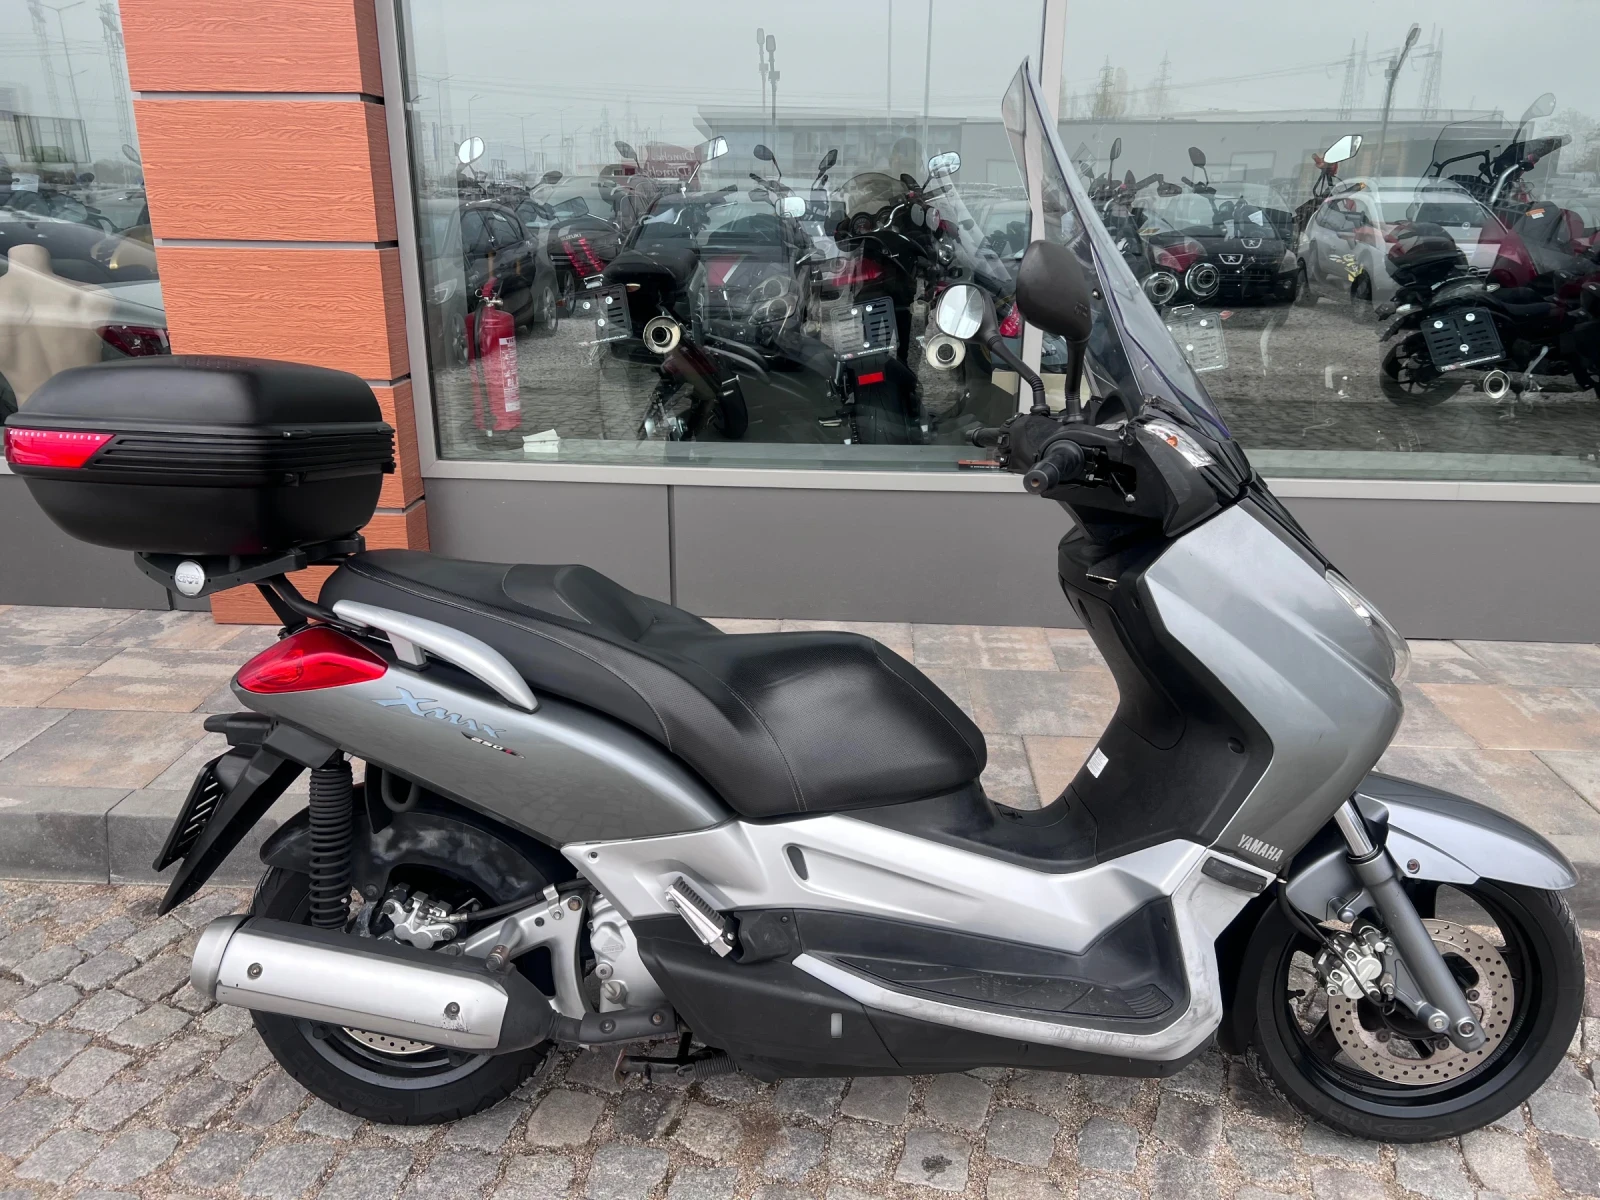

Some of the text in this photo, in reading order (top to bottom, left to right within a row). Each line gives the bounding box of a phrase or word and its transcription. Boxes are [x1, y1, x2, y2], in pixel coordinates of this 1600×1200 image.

[560, 233, 582, 242] SUZUKI
[177, 573, 199, 585] GIVI
[1237, 834, 1284, 862] YAMAHA
